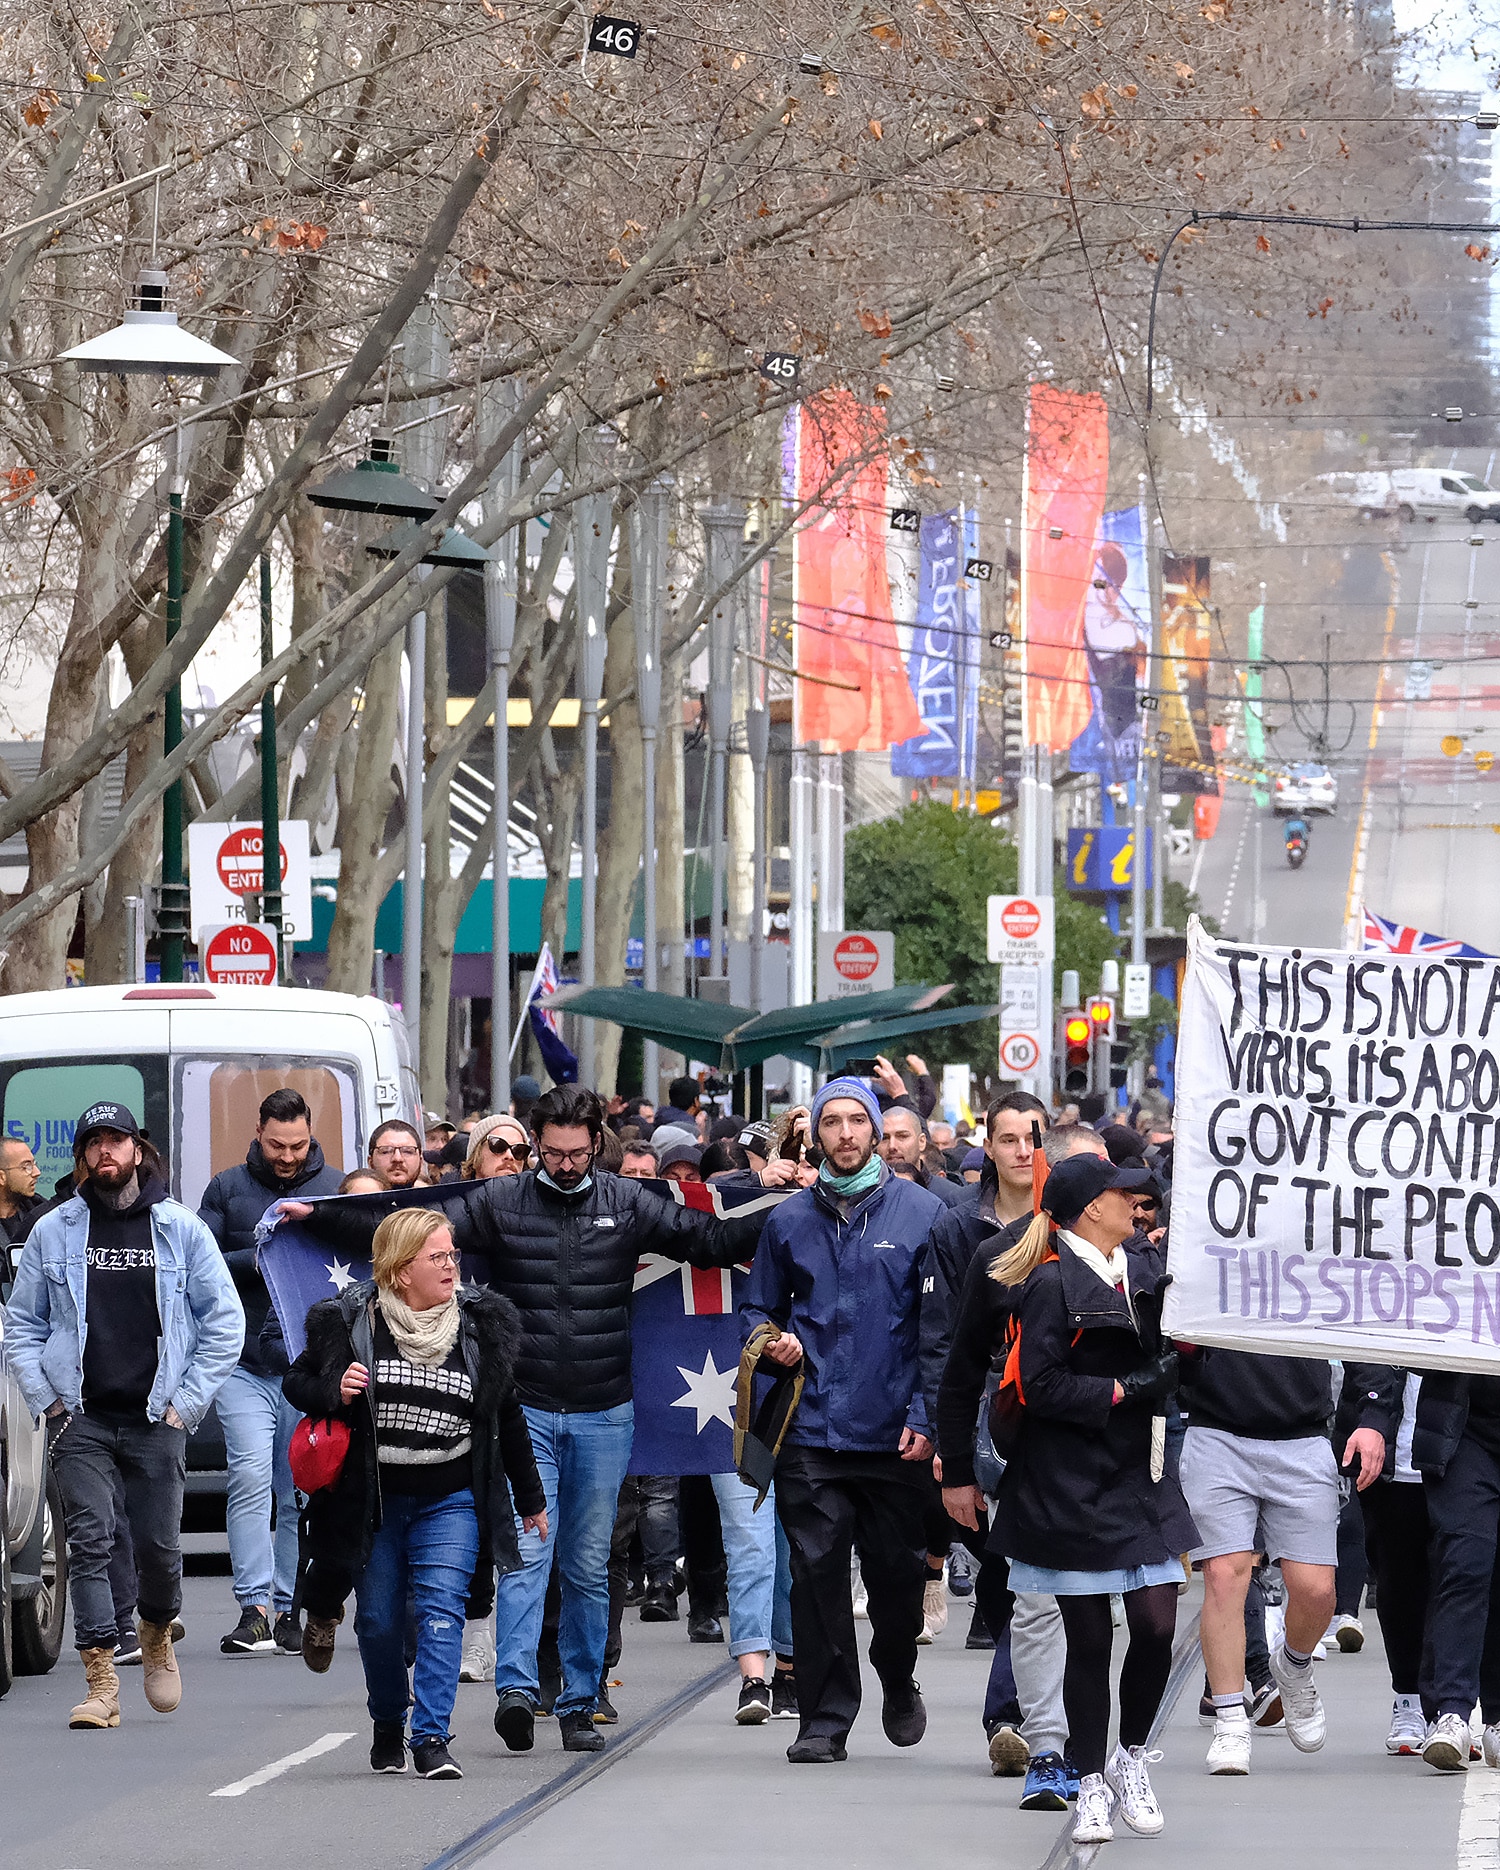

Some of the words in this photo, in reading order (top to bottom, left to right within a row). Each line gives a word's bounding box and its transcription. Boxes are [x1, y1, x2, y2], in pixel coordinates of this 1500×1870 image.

[595, 25, 634, 52] 46
[767, 357, 796, 378] 45
[893, 513, 917, 530] 44
[967, 562, 989, 579] 43
[991, 634, 1011, 648] 42
[241, 838, 264, 853] NO
[229, 937, 252, 953] NO
[849, 941, 865, 952] NO
[1006, 940, 1038, 949] TRAMS
[217, 973, 265, 985] ENTRY
[1343, 957, 1385, 1036] IS
[1388, 959, 1484, 1040] NOT
[1011, 1045, 1029, 1061] 10
[1208, 1099, 1346, 1172] GOVT
[1207, 1169, 1279, 1238] OF
[1290, 1178, 1392, 1261] THE
[1204, 1245, 1313, 1324] THIS
[1317, 1259, 1461, 1334] STOPS
